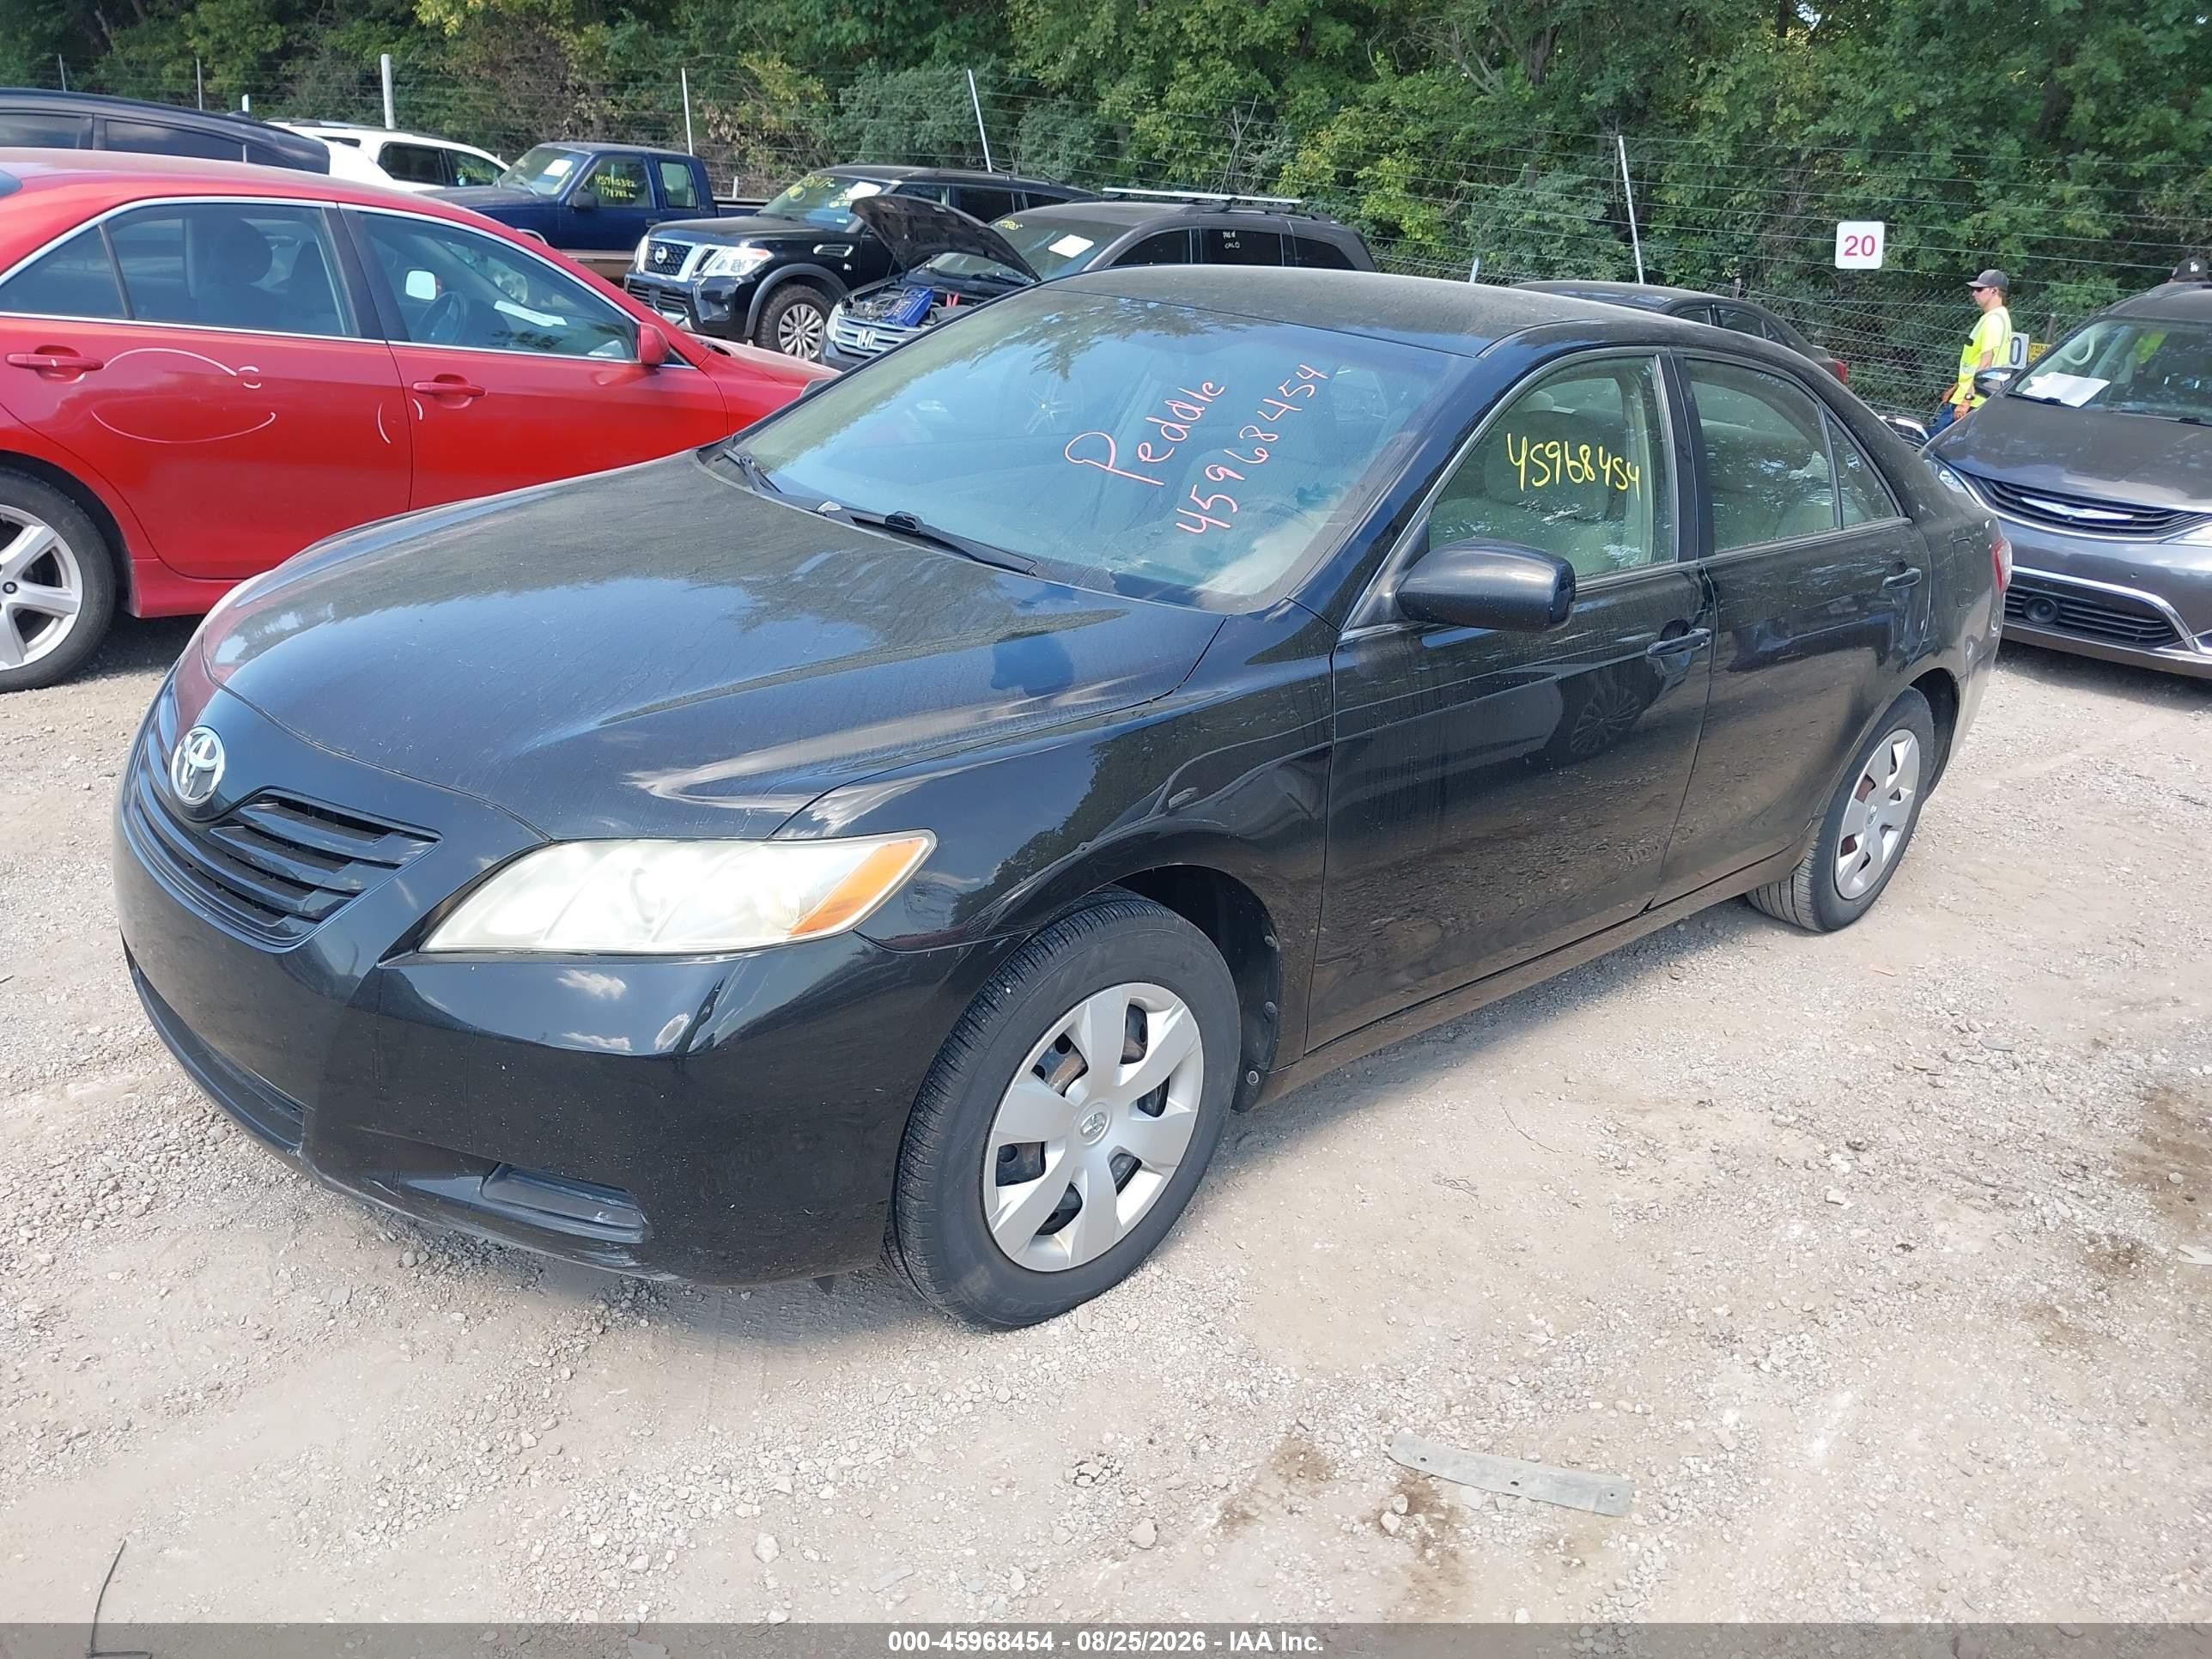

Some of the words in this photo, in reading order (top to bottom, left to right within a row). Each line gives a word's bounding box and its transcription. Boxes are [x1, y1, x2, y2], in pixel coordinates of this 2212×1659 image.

[1844, 234, 1875, 256] 20
[1064, 380, 1226, 486] Peddle
[1175, 363, 1329, 533] 45968454
[1507, 432, 1641, 502] 45968454
